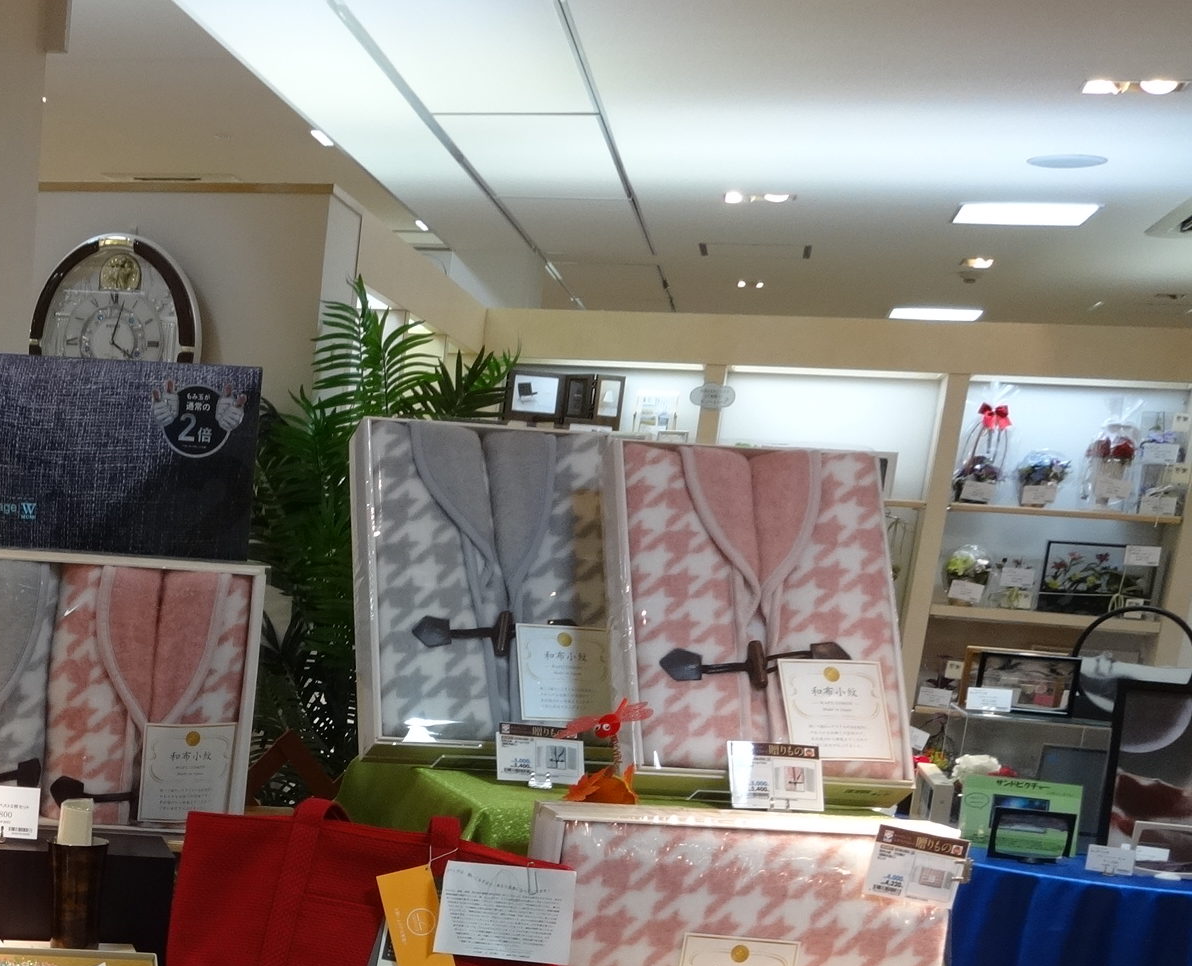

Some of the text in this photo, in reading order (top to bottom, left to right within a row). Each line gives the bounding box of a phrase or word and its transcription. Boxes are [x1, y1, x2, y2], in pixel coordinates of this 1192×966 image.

[185, 401, 211, 411] 通常の
[178, 413, 213, 443] 2倍
[810, 686, 859, 698] 和布小紋
